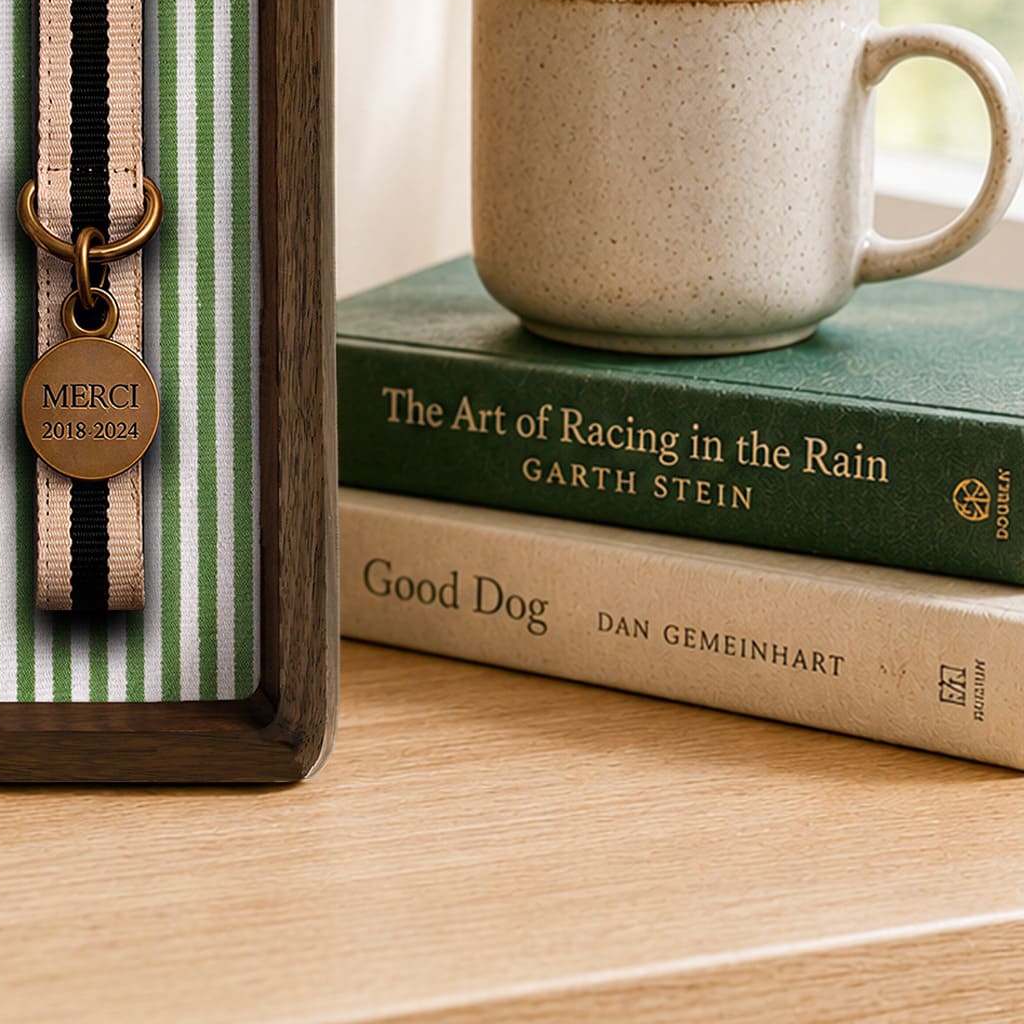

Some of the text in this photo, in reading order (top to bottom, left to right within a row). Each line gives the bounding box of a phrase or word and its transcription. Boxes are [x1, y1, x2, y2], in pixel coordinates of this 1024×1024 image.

[43, 384, 138, 408] MERCI
[42, 422, 138, 440] 2018-2024
[382, 388, 888, 482] The Art of Racing in the Rain
[523, 458, 751, 509] GARTH STEIN
[363, 559, 548, 635] Good Dog
[598, 612, 844, 676] DAN GEMEINHART
